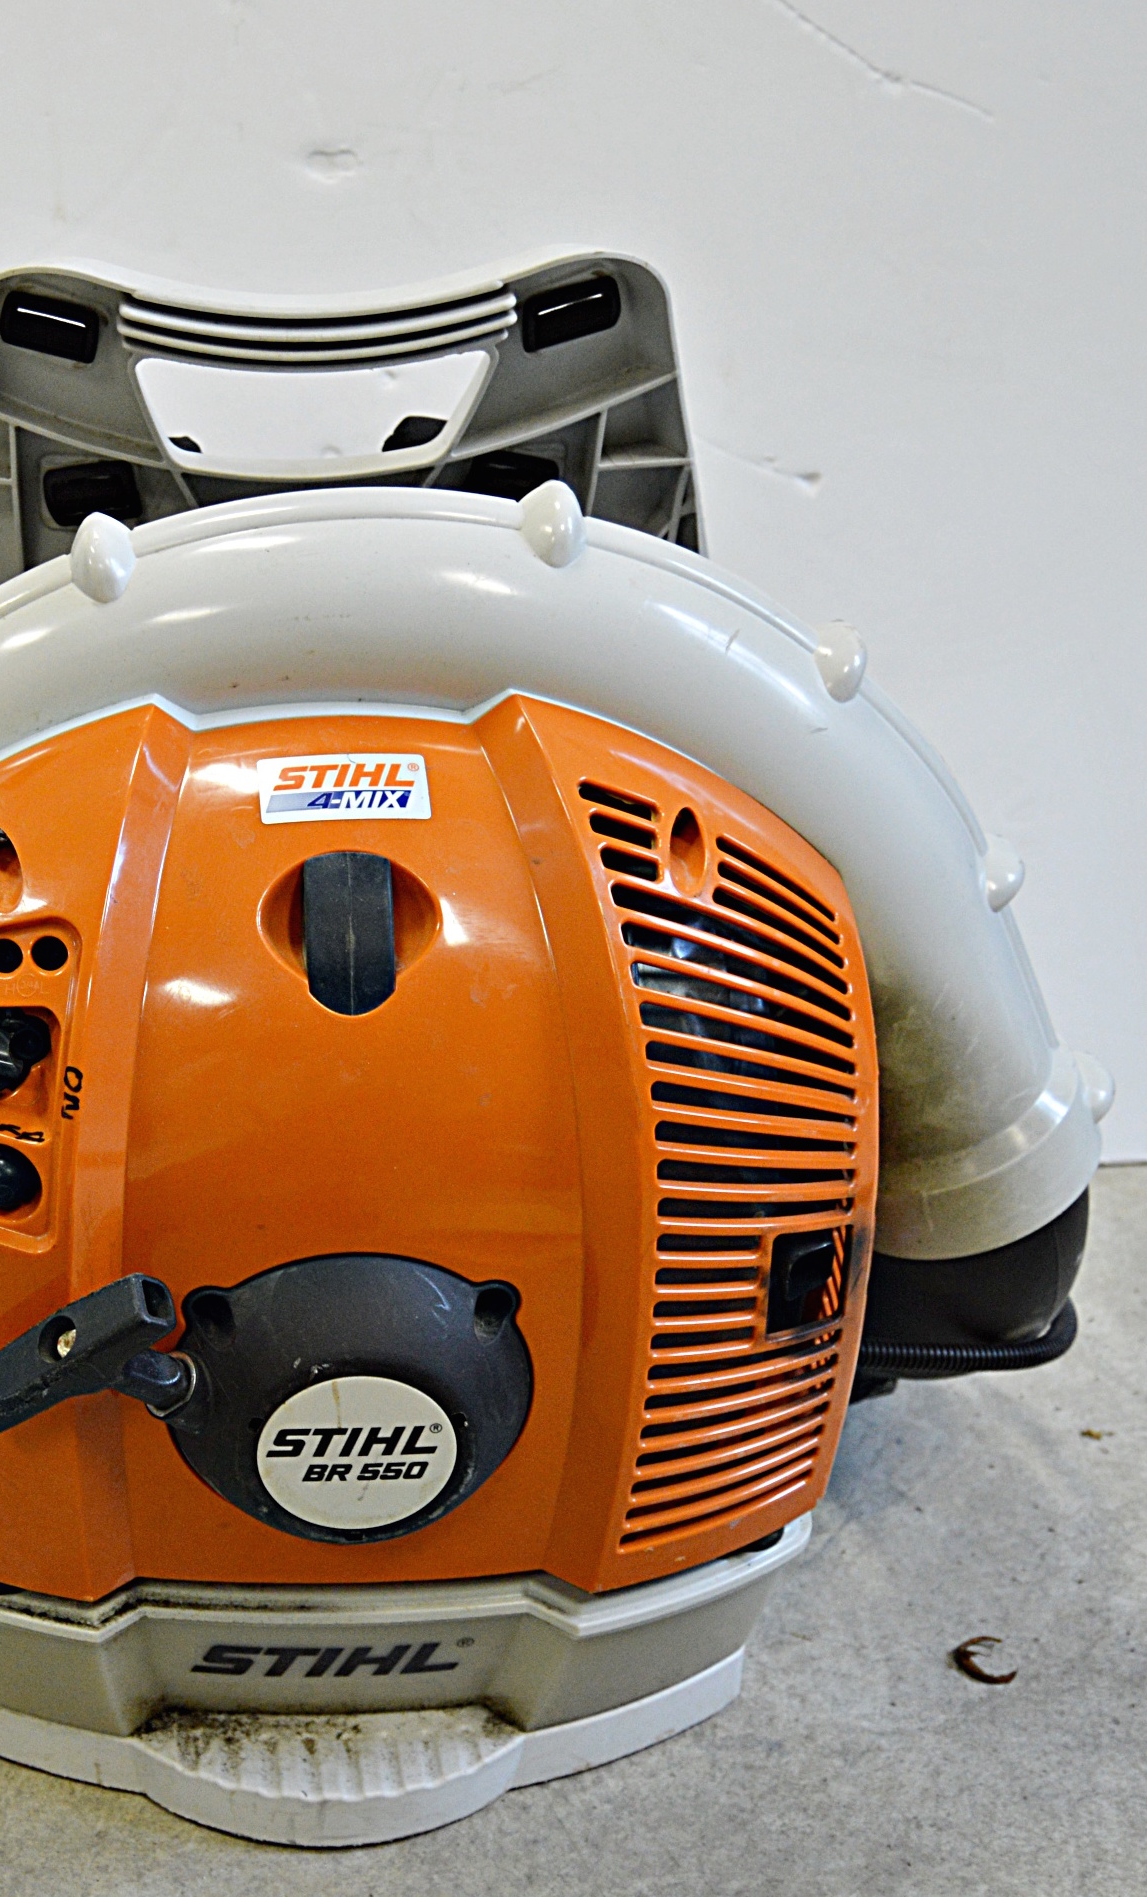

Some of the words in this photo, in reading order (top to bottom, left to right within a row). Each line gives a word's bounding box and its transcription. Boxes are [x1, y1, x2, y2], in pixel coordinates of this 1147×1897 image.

[273, 762, 415, 792] STIHL
[307, 790, 402, 810] 4-MIX
[266, 1425, 438, 1458] STIHL
[302, 1463, 353, 1482] BR
[357, 1461, 429, 1481] 550
[190, 1641, 459, 1678] STIHL
